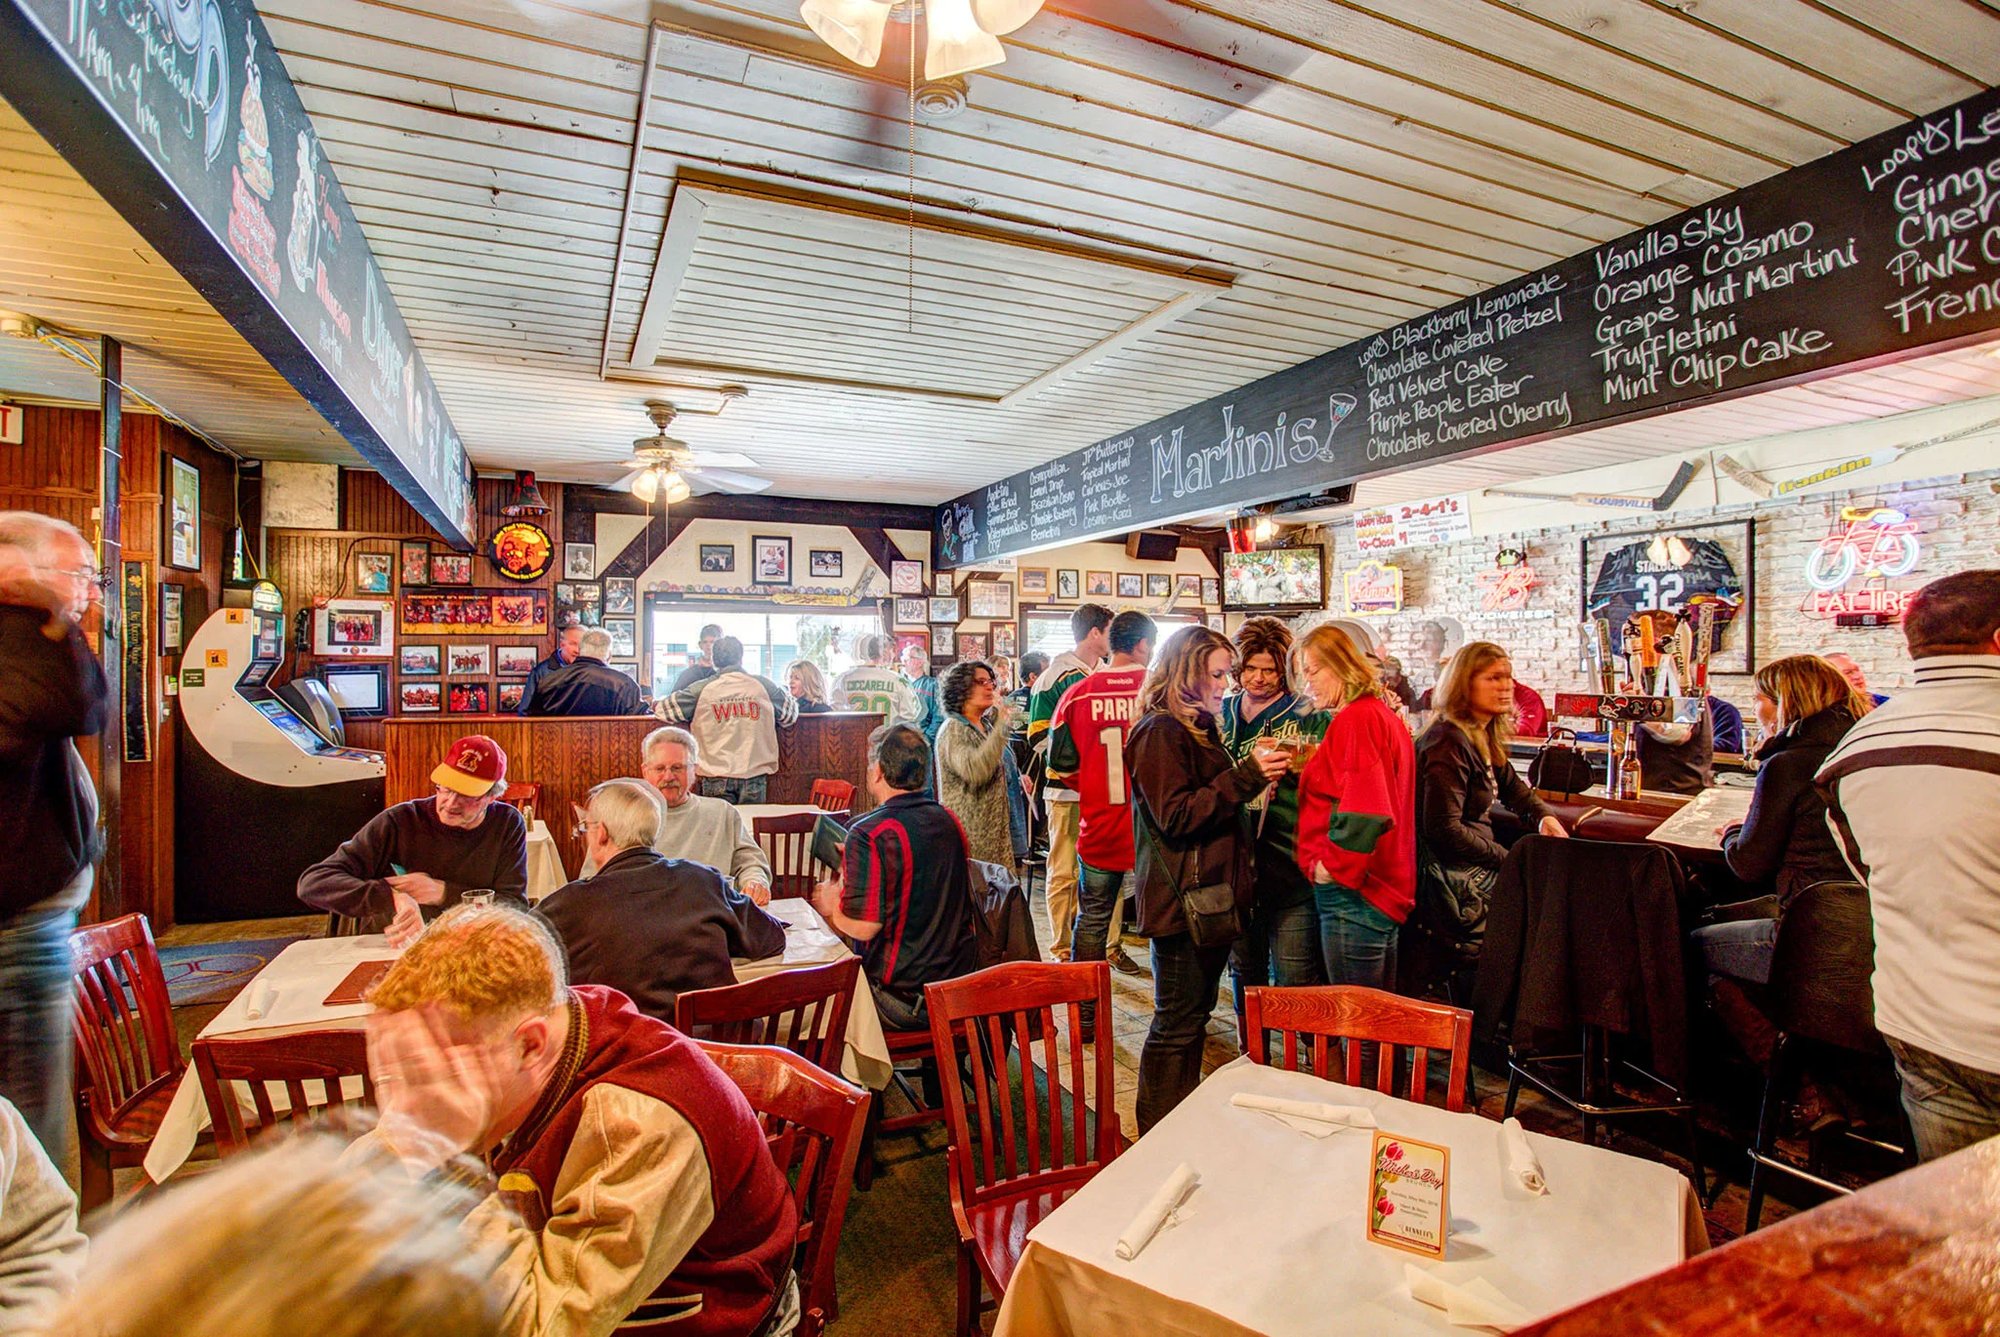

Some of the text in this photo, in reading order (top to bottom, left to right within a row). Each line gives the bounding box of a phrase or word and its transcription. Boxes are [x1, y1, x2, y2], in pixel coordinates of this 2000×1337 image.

[1594, 221, 1814, 312] Orange Cosmo
[1595, 204, 1744, 281] Vanilla Sky
[1392, 306, 1471, 351] Blackberry
[1474, 273, 1567, 321] Lemonade
[1595, 237, 1859, 345] Grape Nut Martini
[1367, 296, 1563, 387] Chocolate Covered Pretzel
[1591, 313, 1737, 375] Truffletini
[1604, 327, 1834, 404] Mint Chip Cake
[1367, 354, 1508, 413] Red Velvet Cake
[1367, 374, 1535, 437] Purple People Eater
[1150, 404, 1319, 503] Martinis
[1367, 391, 1572, 462] Chocolate Covered Cherry
[1105, 453, 1131, 474] Martini
[1635, 573, 1685, 615] 32
[1813, 591, 1859, 613] FAT
[711, 701, 760, 723] WILD
[1420, 1168, 1444, 1190] Day
